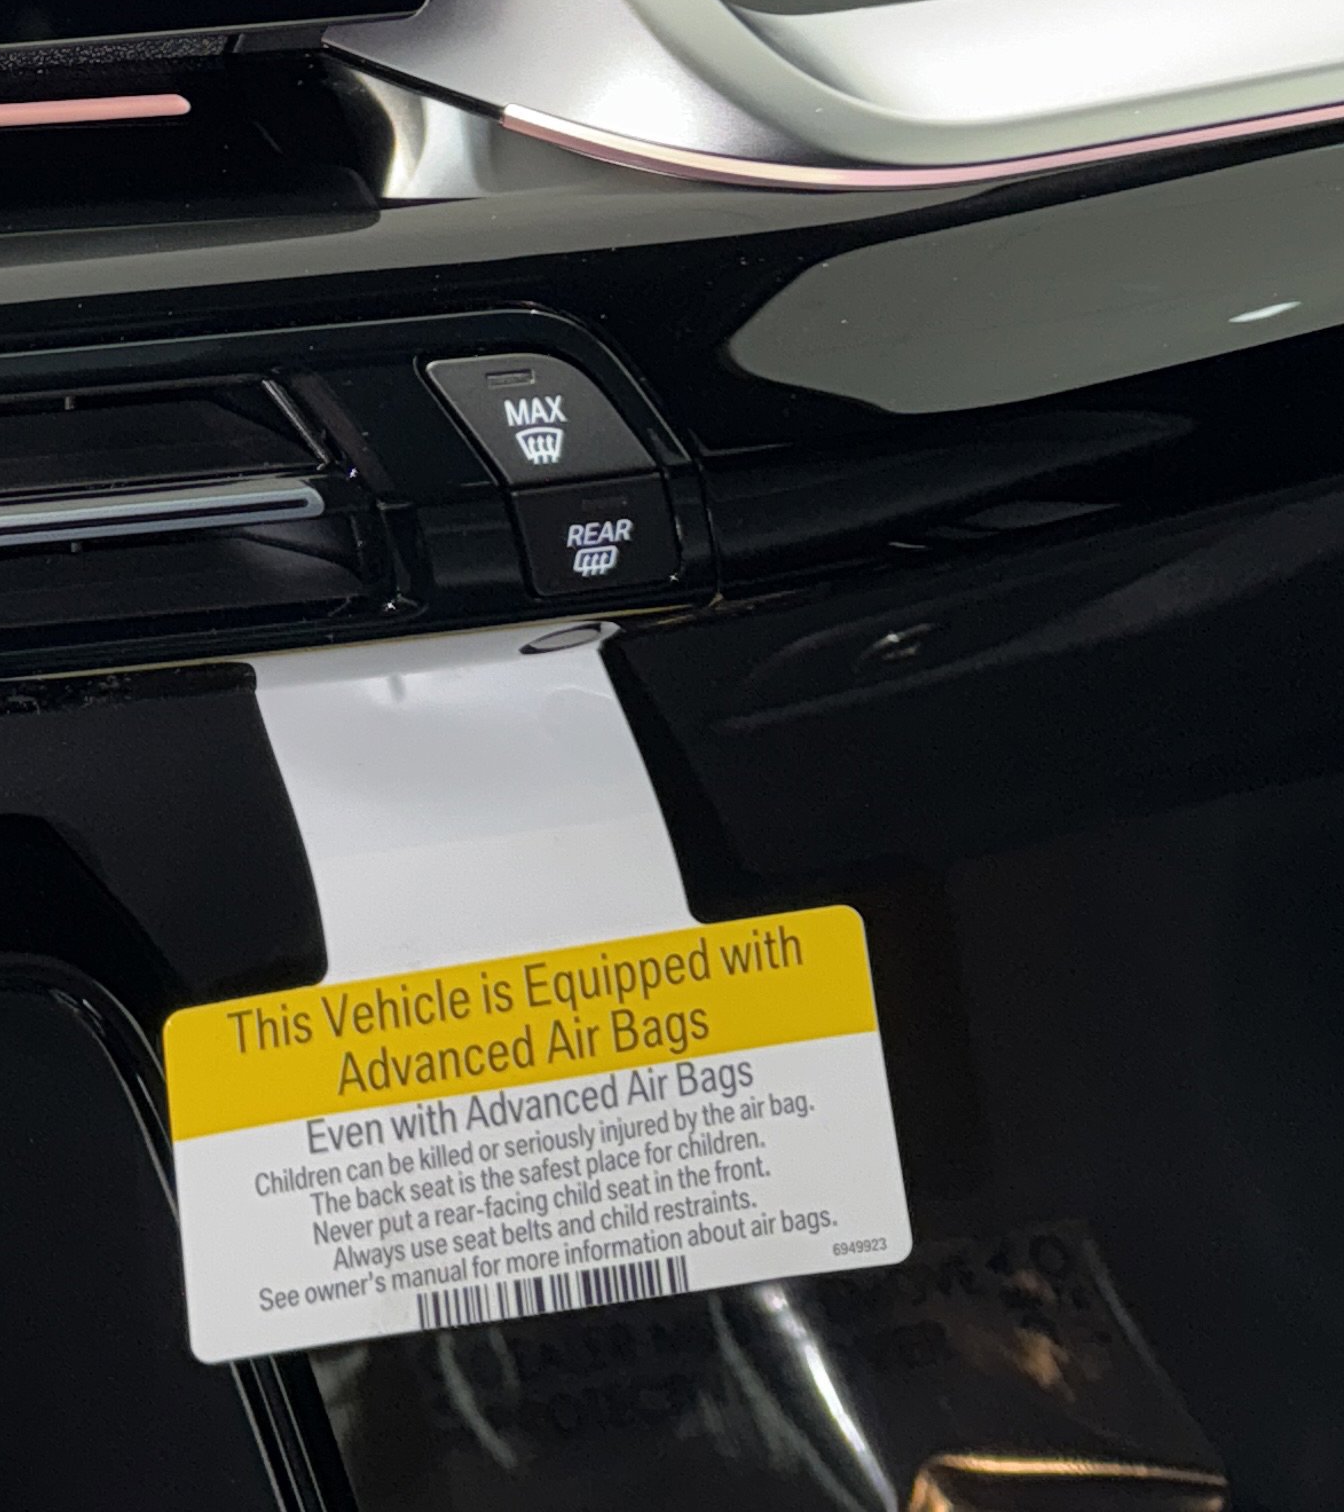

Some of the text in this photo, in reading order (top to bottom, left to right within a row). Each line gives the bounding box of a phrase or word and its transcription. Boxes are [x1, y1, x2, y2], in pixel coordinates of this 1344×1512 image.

[504, 394, 567, 426] MAX
[567, 518, 633, 548] REAR
[227, 925, 803, 1054] This Vehicle is Equipped with
[338, 1008, 710, 1096] Advanced Air Bags
[254, 1092, 815, 1197] Children can be killed or seriously injured by the air bag.
[306, 1061, 754, 1154] Even with Advanced Air Bags
[310, 1131, 766, 1216] The back seat is the safest place for children.
[313, 1156, 771, 1245] Never put a rear-facing child seat in the front.
[259, 1209, 838, 1312] See owner's manual for more information about air bags.
[333, 1190, 757, 1271] Always use seat belts and child restraints.
[832, 1237, 888, 1256] 6949923
